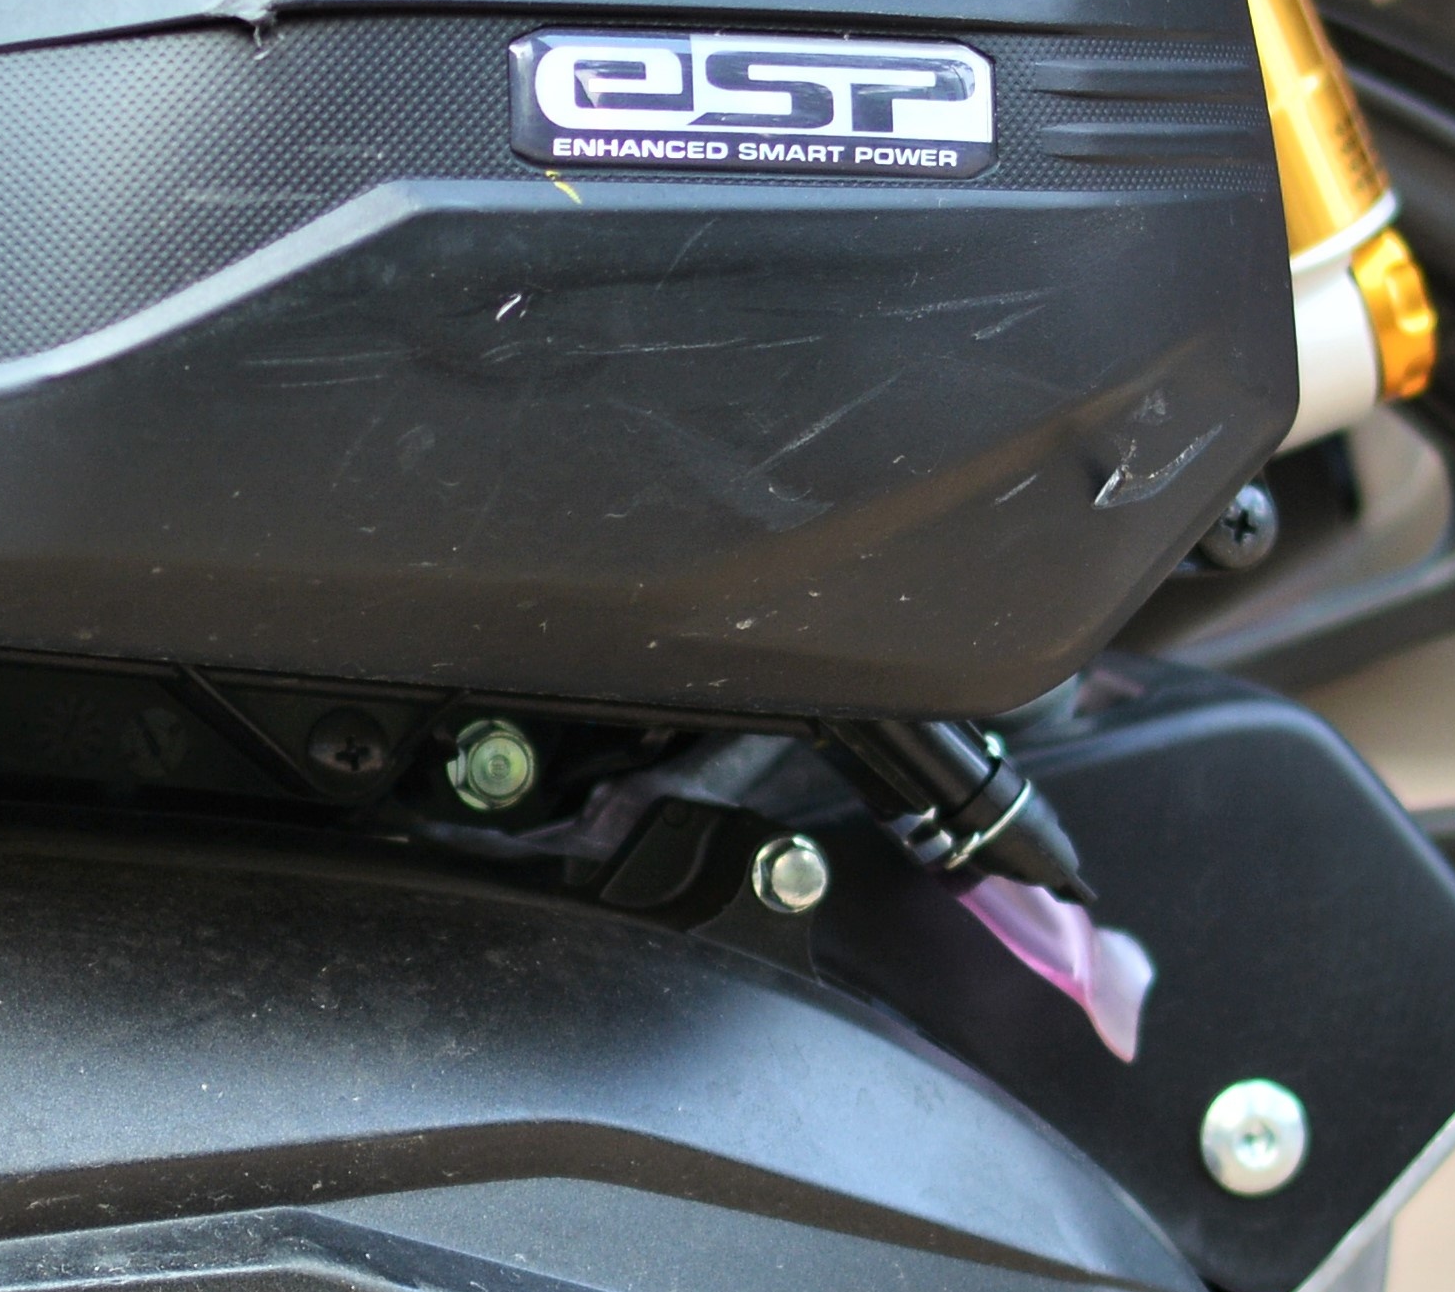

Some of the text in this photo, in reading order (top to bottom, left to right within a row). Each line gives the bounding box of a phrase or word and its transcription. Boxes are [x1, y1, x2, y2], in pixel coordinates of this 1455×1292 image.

[552, 137, 959, 168] ENHANCED SMART POWER
